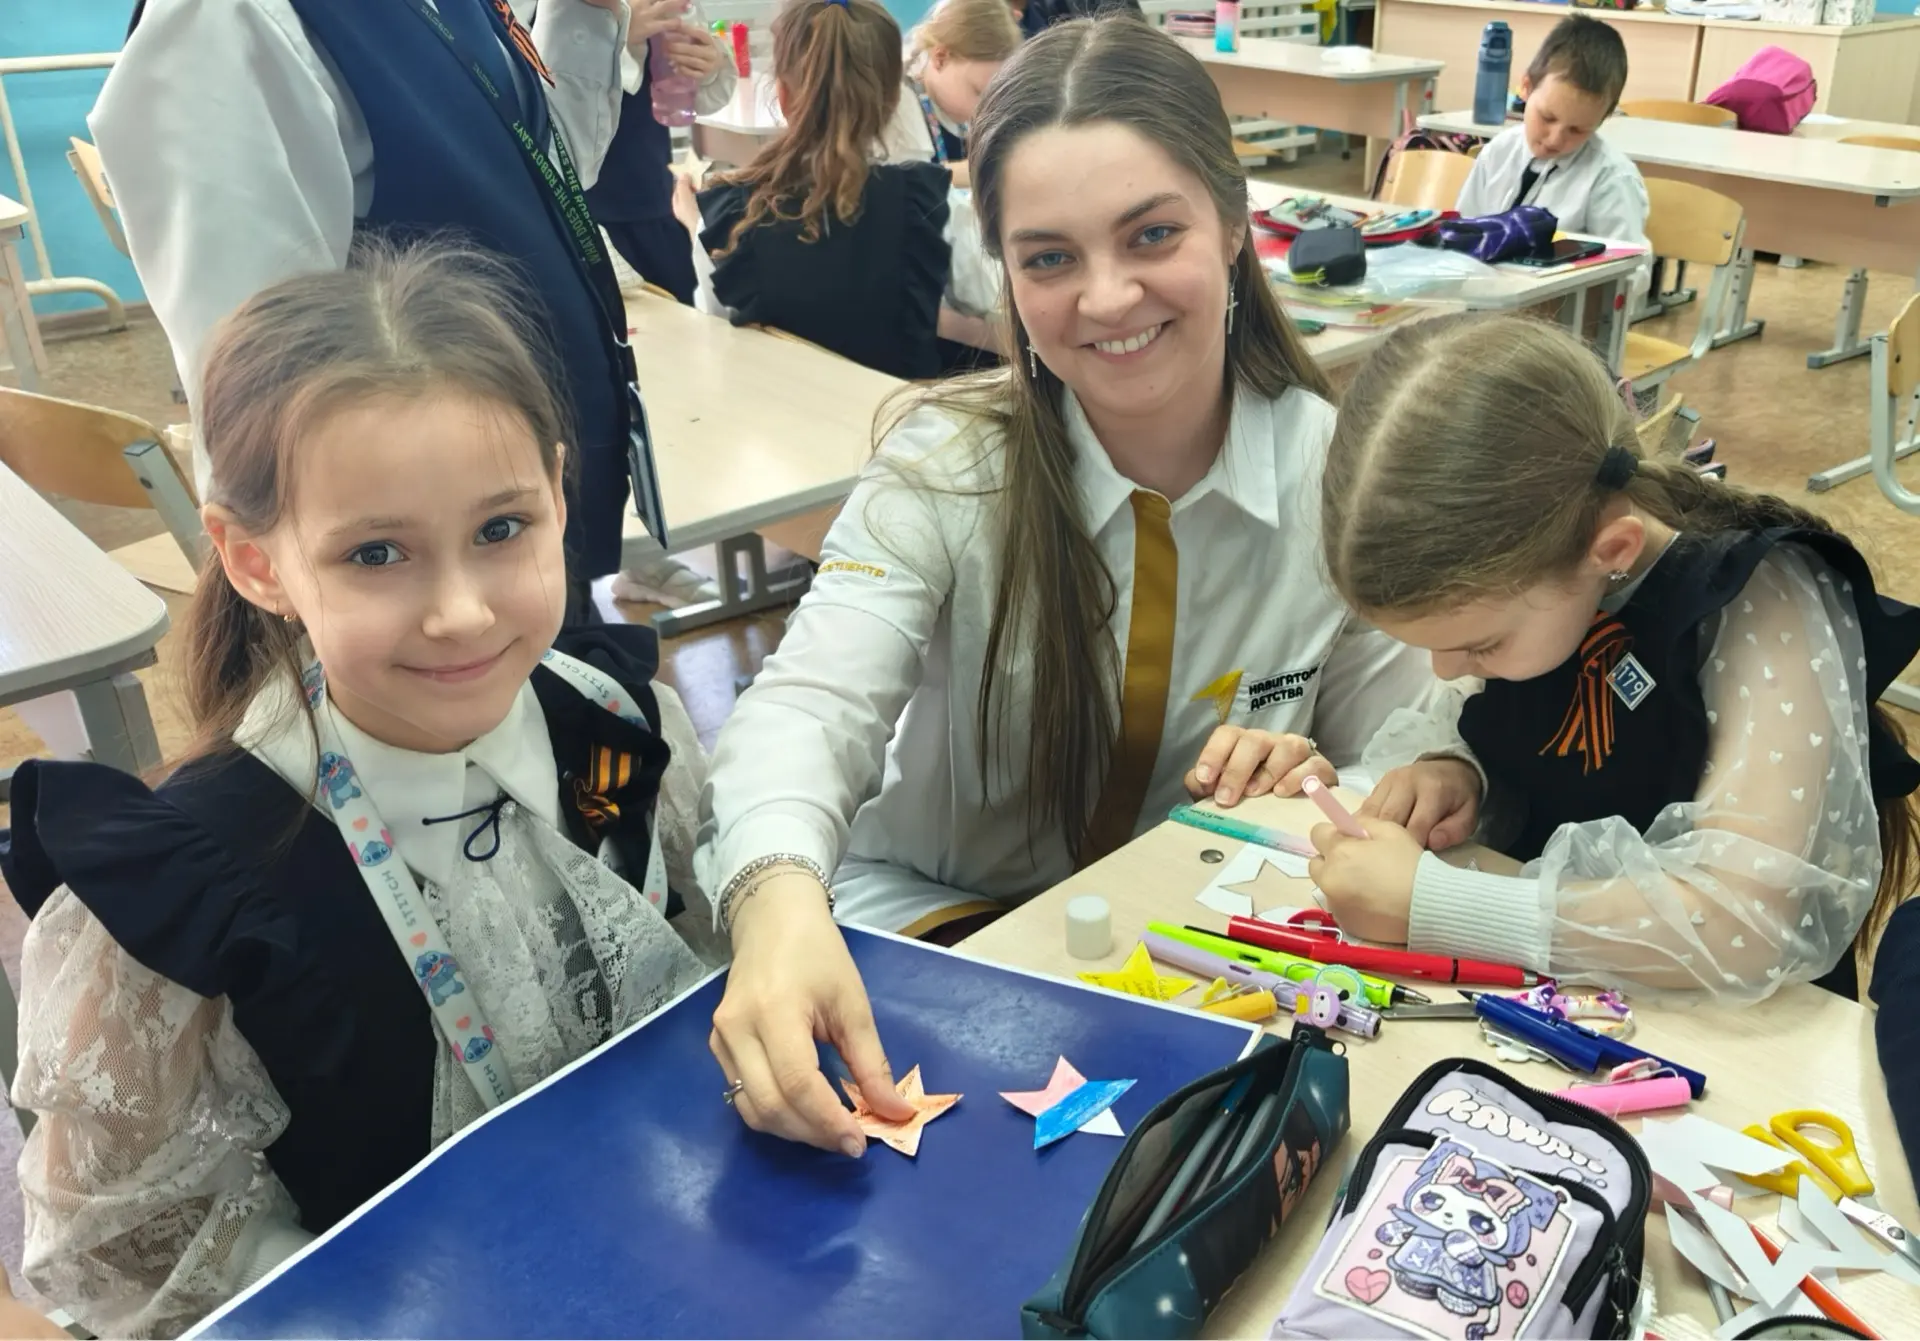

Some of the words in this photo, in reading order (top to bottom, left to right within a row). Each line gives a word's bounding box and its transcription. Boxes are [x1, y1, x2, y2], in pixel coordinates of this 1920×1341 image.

[512, 119, 534, 149] SAY?
[531, 150, 558, 187] ROBOT
[553, 185, 572, 209] THE
[565, 167, 580, 193] THE
[575, 194, 596, 234] ROB
[566, 207, 588, 237] DOES
[579, 233, 601, 264] WHAT
[560, 660, 610, 699] STITCH
[1616, 665, 1645, 696] 179
[1250, 686, 1304, 712] ДЕТСТВА
[381, 869, 417, 928] STITCH
[483, 1063, 505, 1100] TITCH
